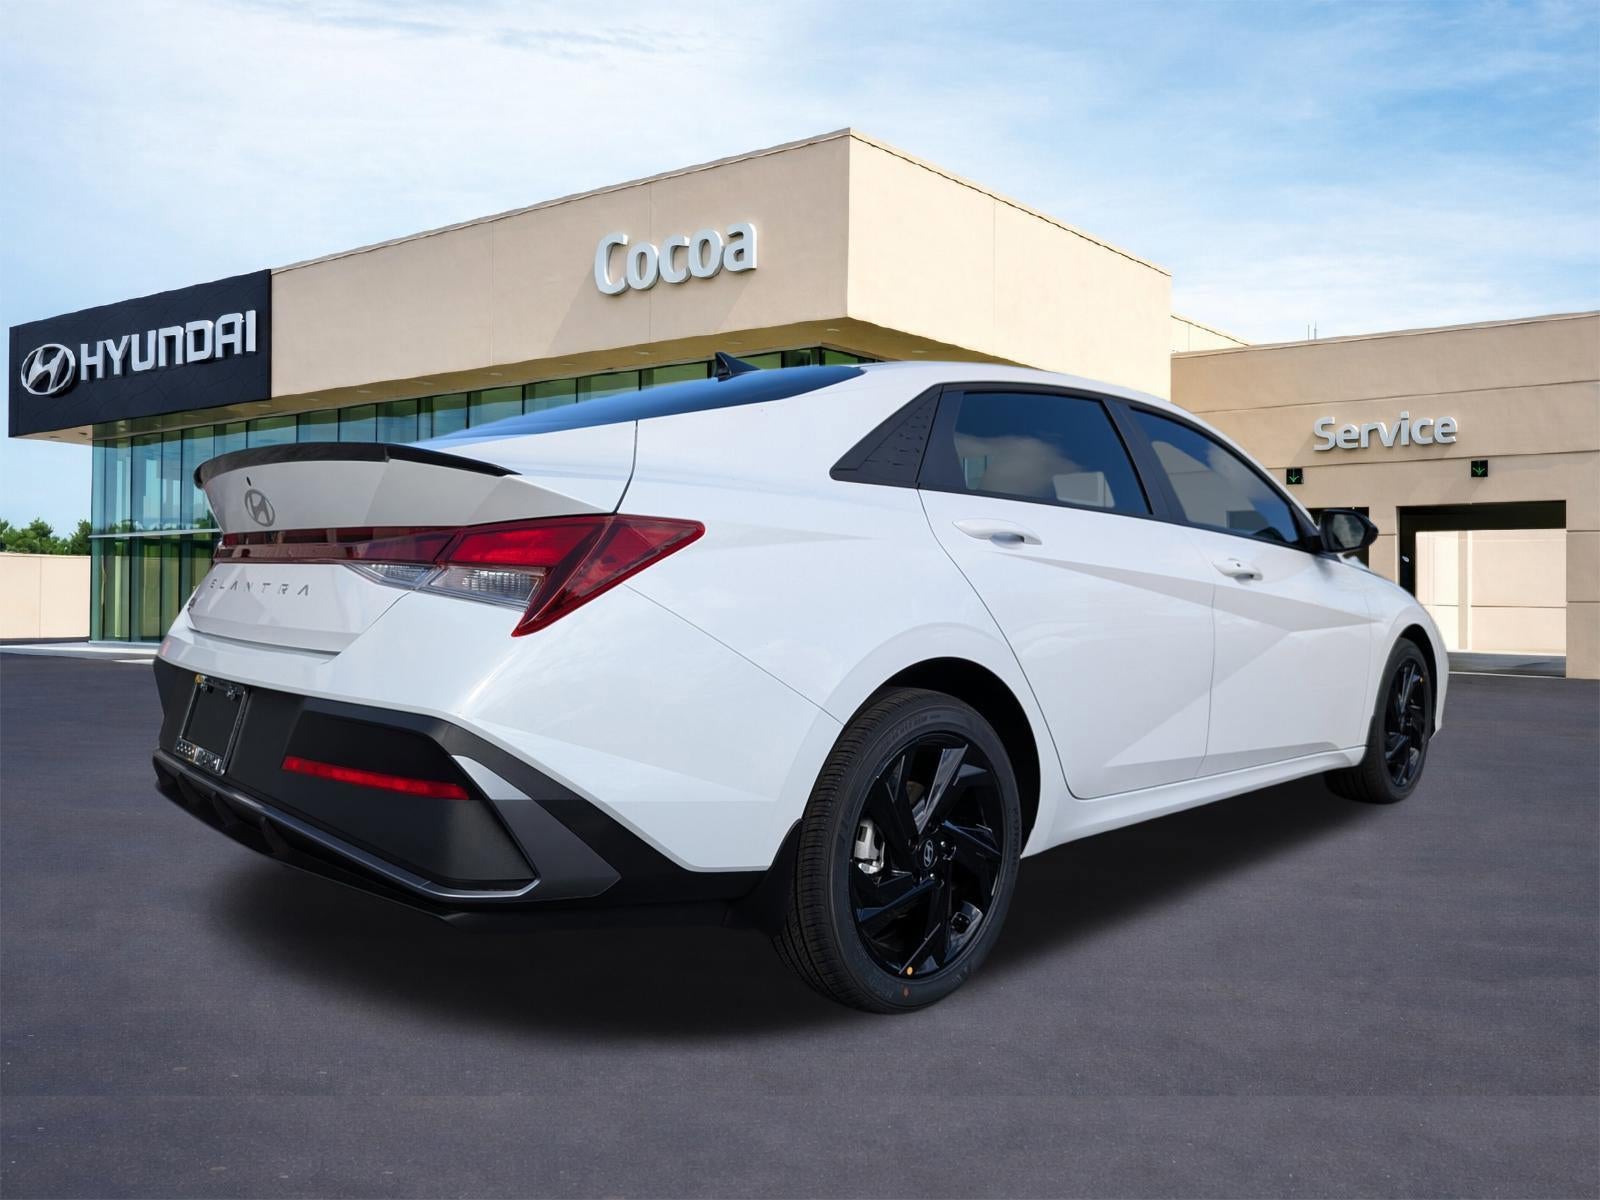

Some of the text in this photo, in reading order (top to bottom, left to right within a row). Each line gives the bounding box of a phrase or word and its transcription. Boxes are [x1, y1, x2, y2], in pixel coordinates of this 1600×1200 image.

[594, 222, 757, 295] Cocoa
[80, 309, 256, 381] HYUNDAI
[1313, 411, 1458, 451] Service
[209, 578, 310, 596] ELANTRA
